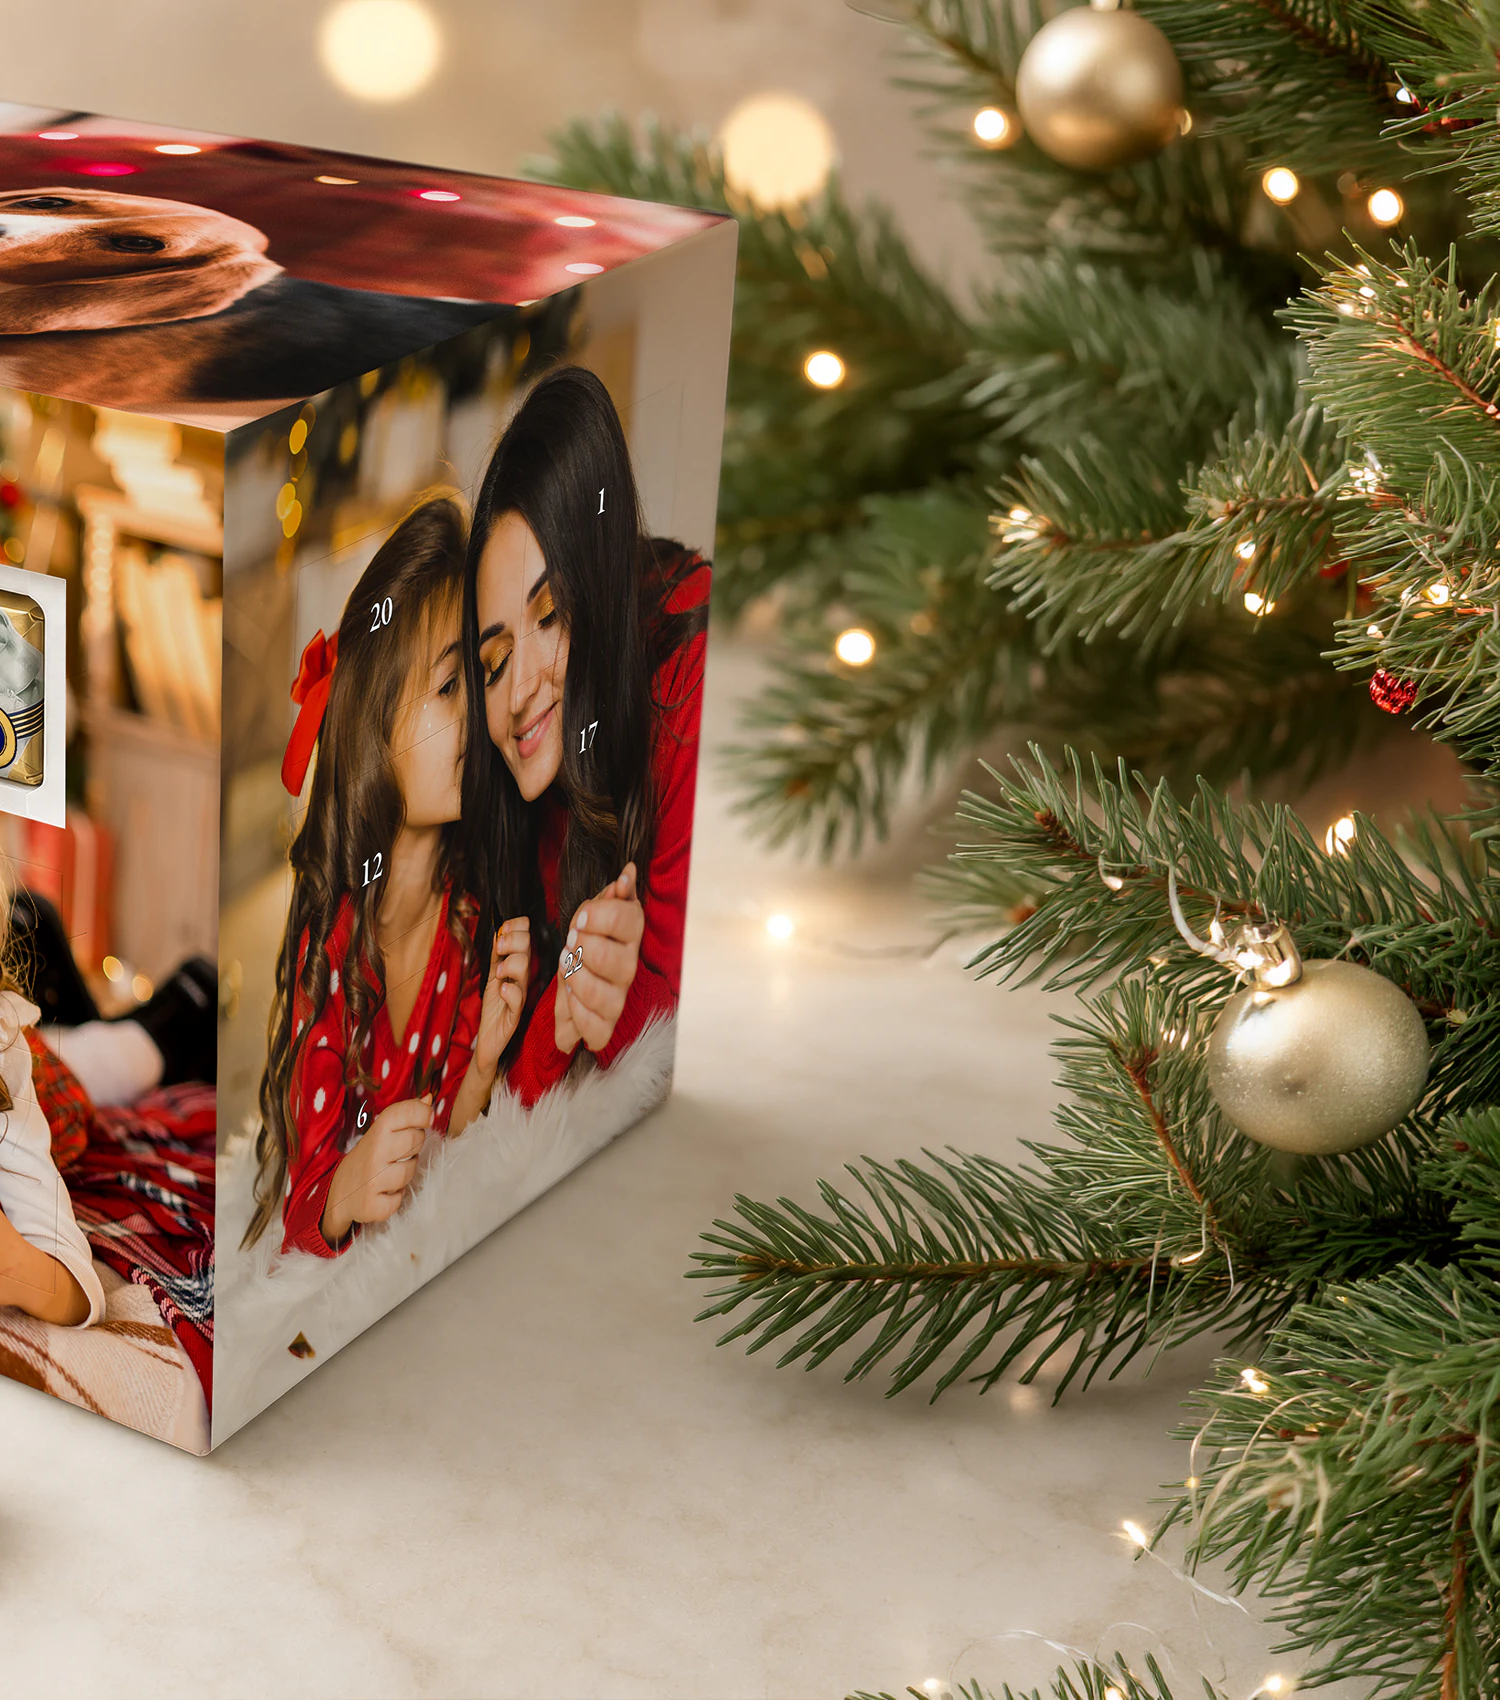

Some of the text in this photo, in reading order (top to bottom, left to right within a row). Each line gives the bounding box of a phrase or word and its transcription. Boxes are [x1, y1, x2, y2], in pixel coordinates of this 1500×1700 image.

[597, 487, 606, 516] 1
[369, 596, 393, 633] 20
[579, 720, 599, 754] 17
[361, 852, 384, 887] 12
[563, 945, 584, 980] 22
[356, 1099, 368, 1129] 6
